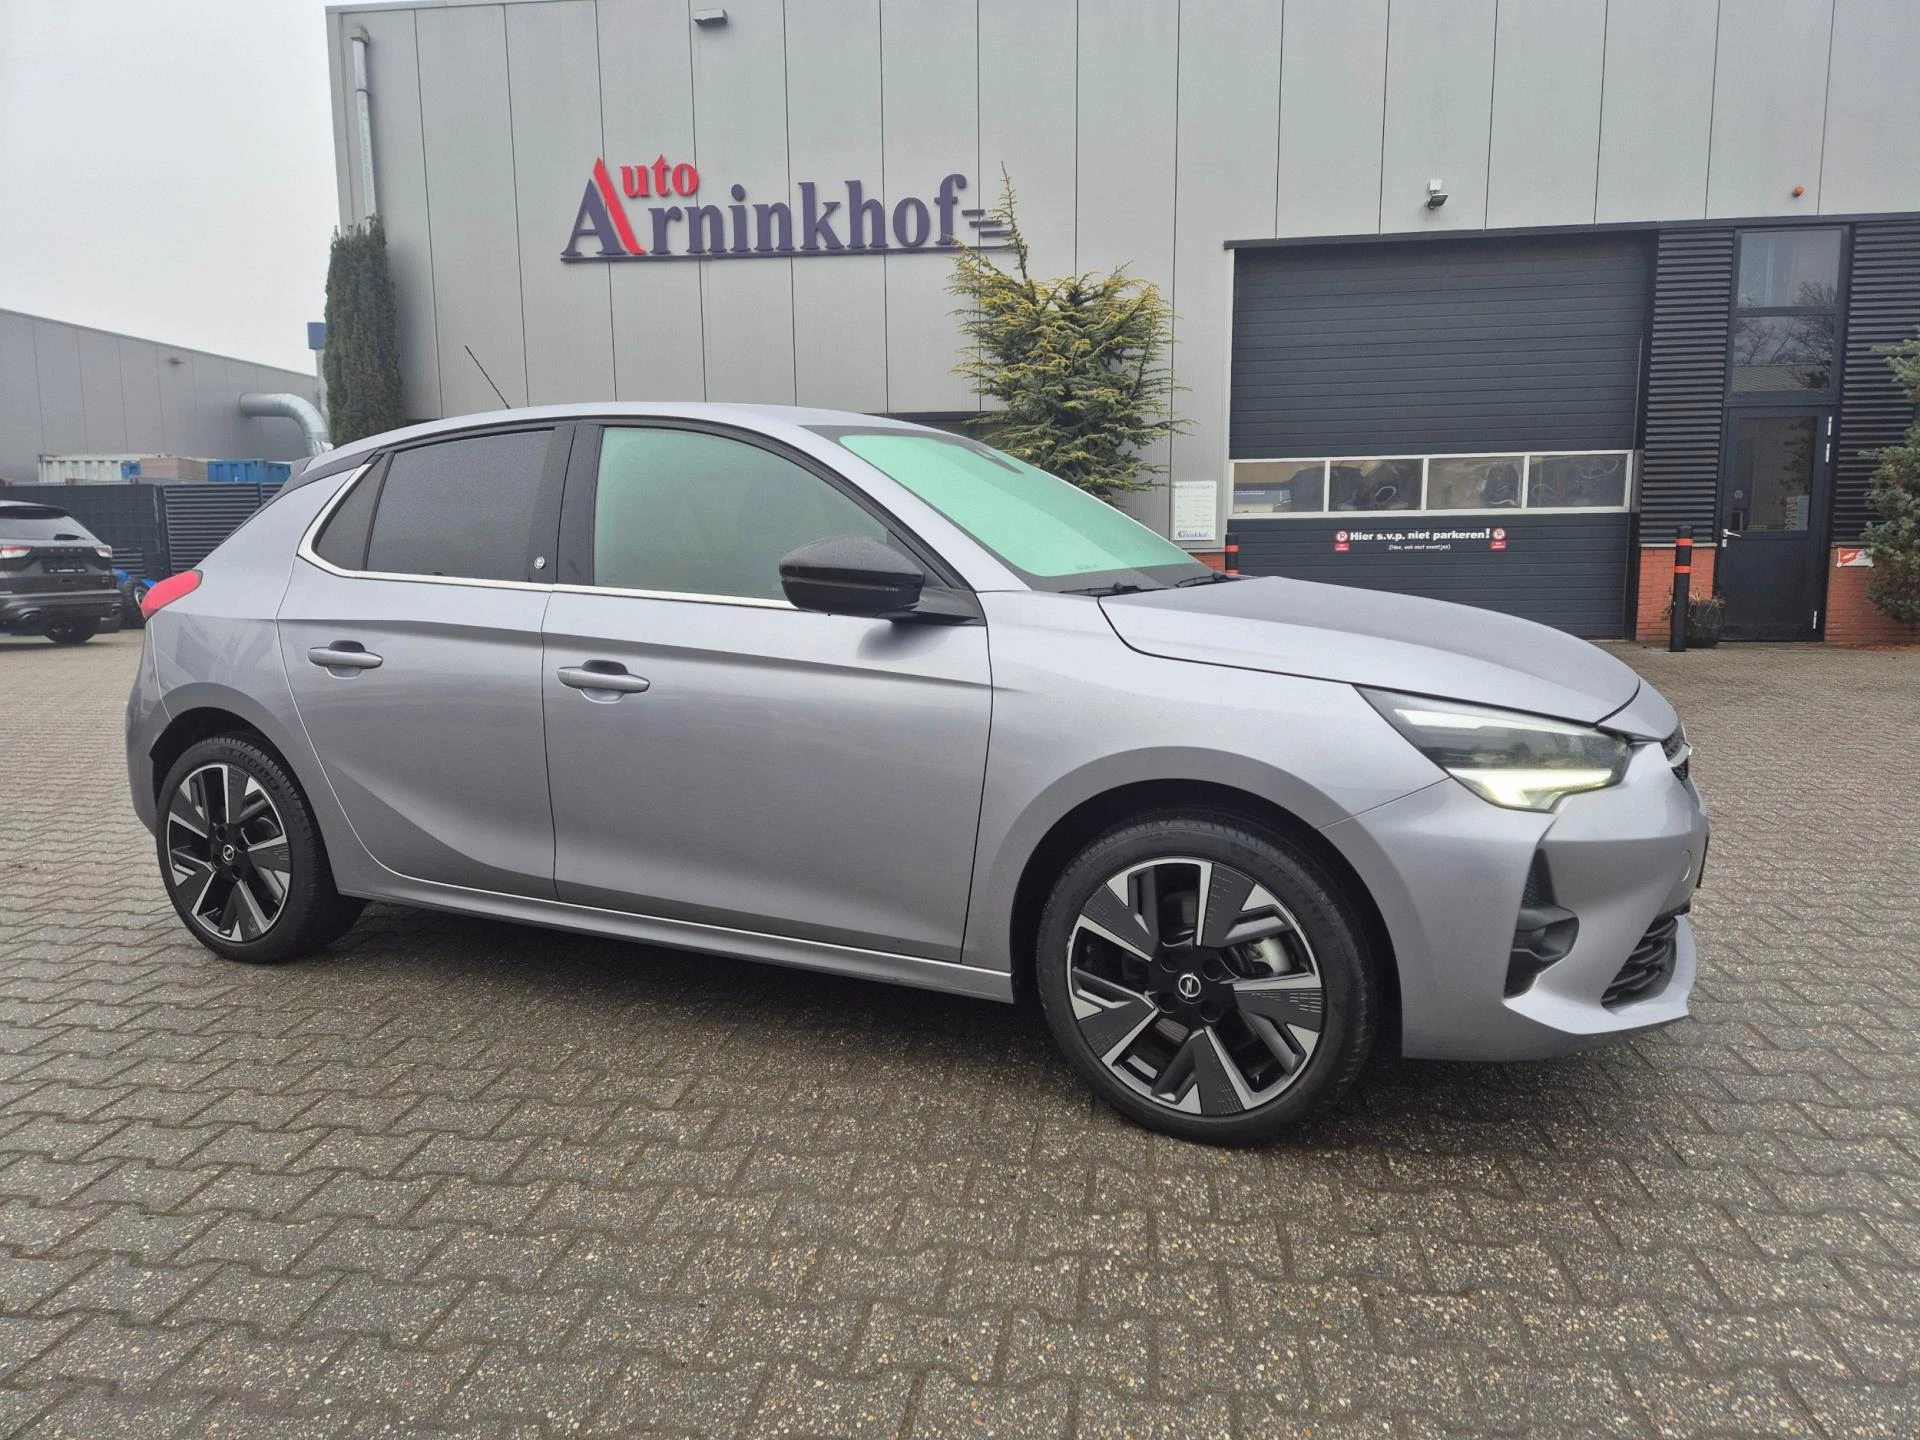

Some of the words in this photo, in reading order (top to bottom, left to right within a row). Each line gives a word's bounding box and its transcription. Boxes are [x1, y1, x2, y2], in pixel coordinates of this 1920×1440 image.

[561, 173, 967, 256] Arninkhof
[1350, 531, 1374, 541] Hier
[1376, 532, 1406, 542] s.v.p.
[1407, 531, 1430, 540] niet
[1433, 528, 1491, 541] parkeren!
